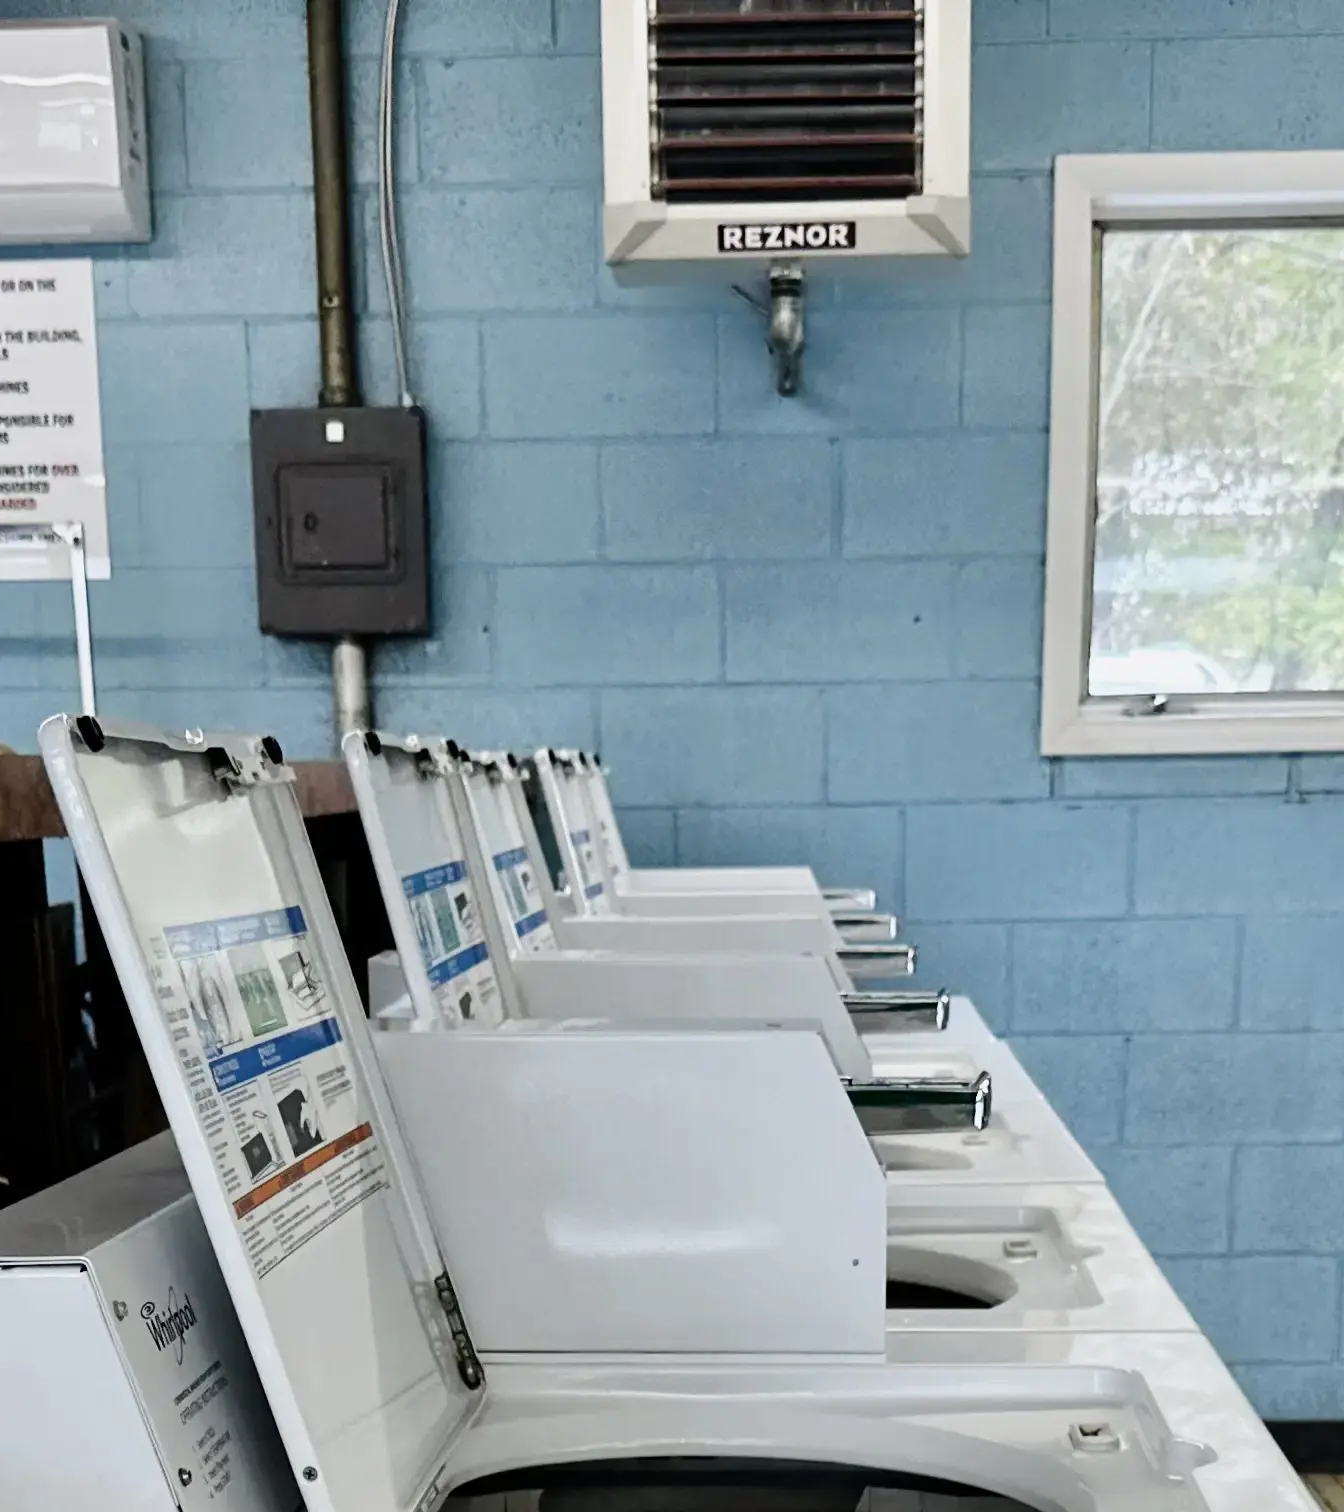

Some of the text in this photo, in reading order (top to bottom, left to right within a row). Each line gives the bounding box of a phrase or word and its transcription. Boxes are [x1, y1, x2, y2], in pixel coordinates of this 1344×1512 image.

[722, 223, 849, 250] REZNOR
[1, 279, 16, 293] OR
[18, 279, 34, 292] ON
[4, 330, 23, 343] THE
[53, 413, 74, 428] FOR
[27, 464, 48, 477] FOR
[52, 464, 80, 477] OVER
[143, 1287, 197, 1364] Whirlpool
